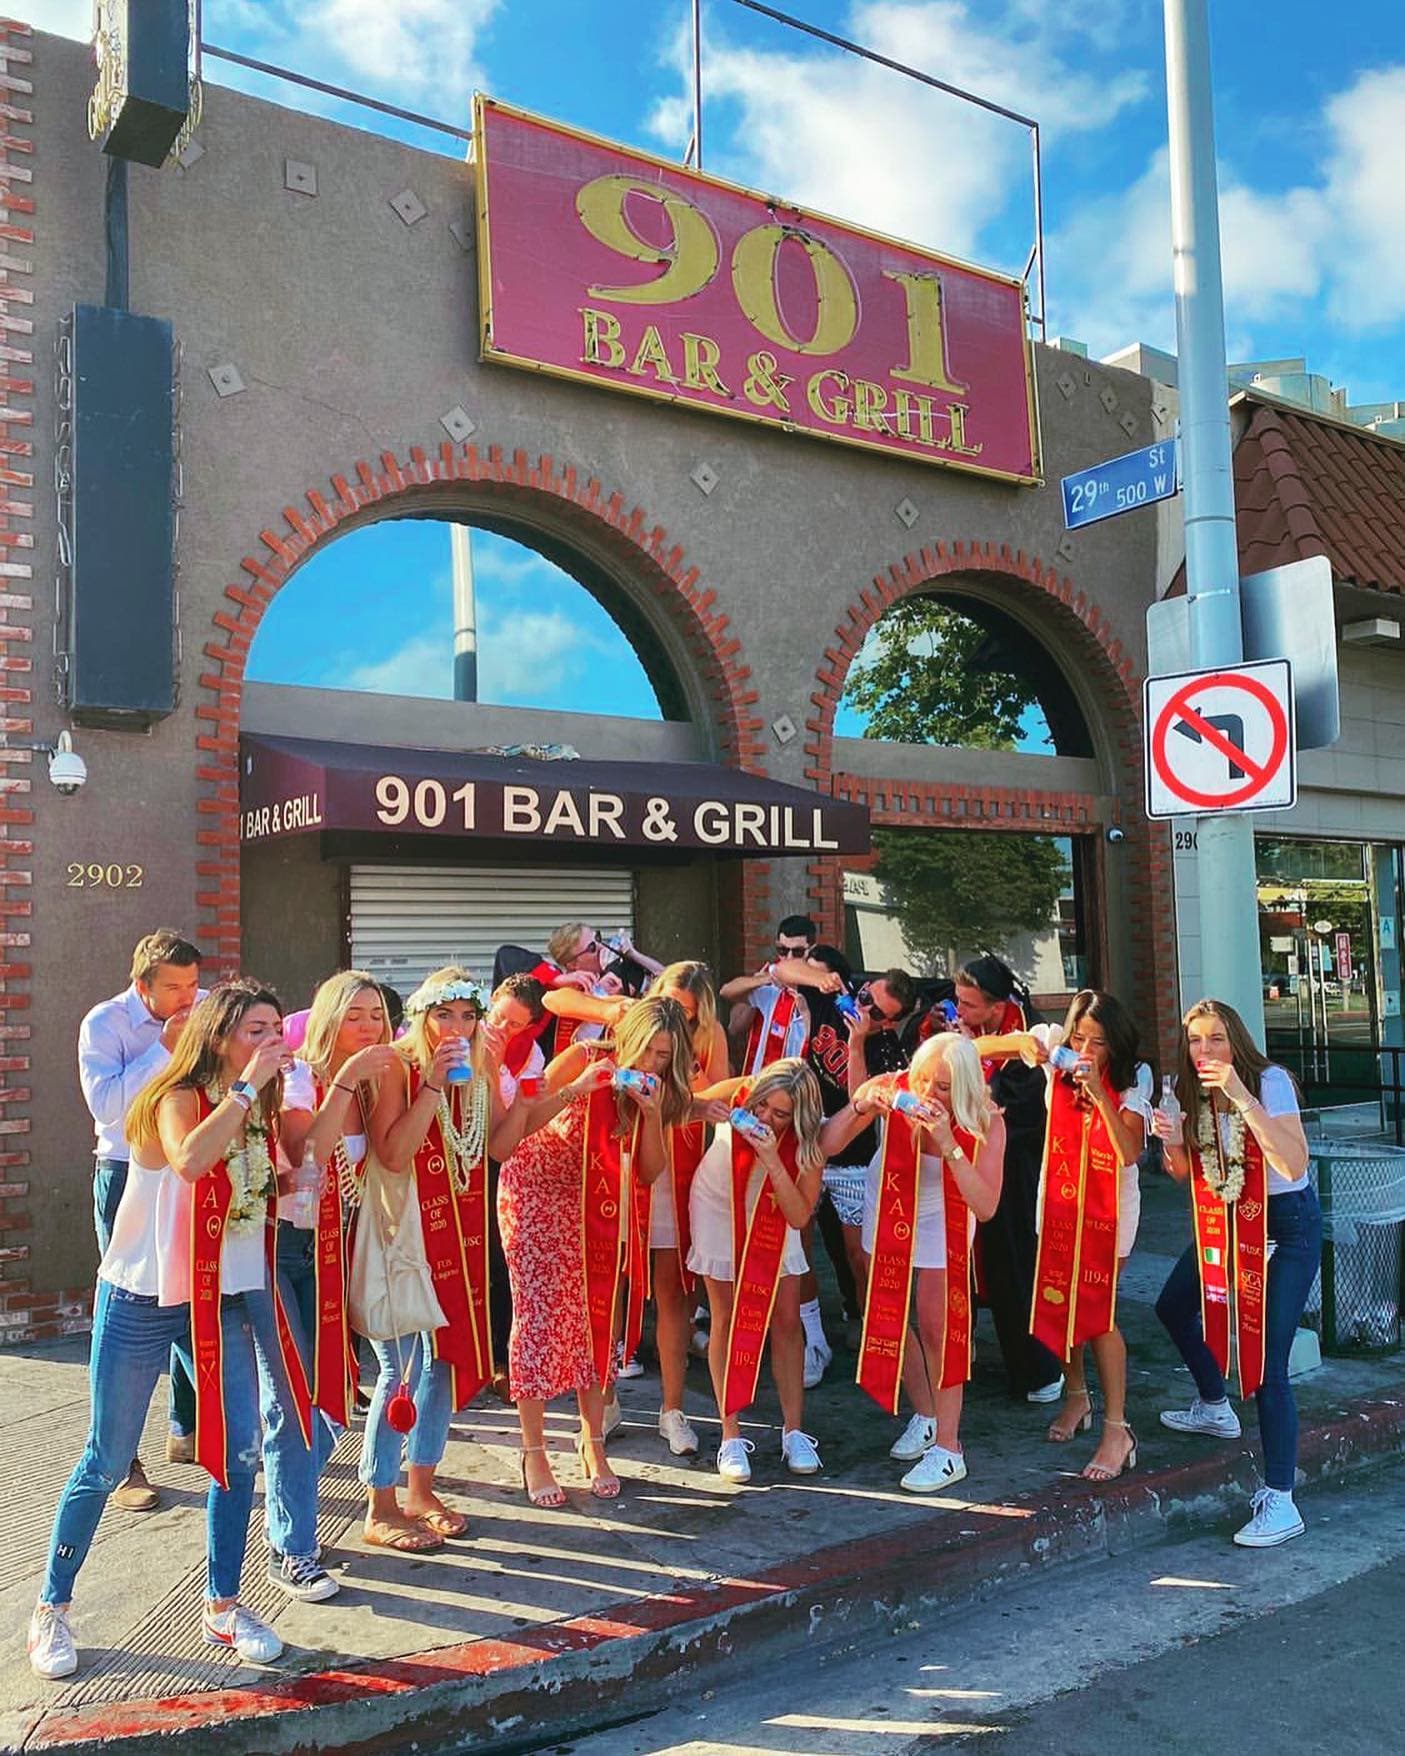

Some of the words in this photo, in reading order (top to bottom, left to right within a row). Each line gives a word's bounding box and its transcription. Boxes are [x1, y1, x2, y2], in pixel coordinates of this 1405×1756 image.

[575, 173, 970, 396] 901
[580, 308, 735, 398] BAR
[743, 351, 795, 413] &
[807, 368, 983, 456] GRILL
[1149, 447, 1166, 469] St
[1116, 481, 1147, 508] 500
[1153, 474, 1167, 494] W
[246, 806, 270, 839] BAR
[272, 803, 281, 833] &
[284, 792, 322, 831] GRILL
[375, 775, 477, 830] 901
[503, 785, 626, 839] BAR
[641, 797, 678, 843] &
[694, 801, 839, 850] GRILL
[67, 863, 143, 888] 2902
[421, 1194, 449, 1211] CLASS
[1199, 1205, 1225, 1216] CLASS
[464, 1234, 482, 1248] USC
[196, 1260, 218, 1272] CLASS
[877, 1255, 907, 1266] CLASS
[57, 1544, 74, 1559] HI
